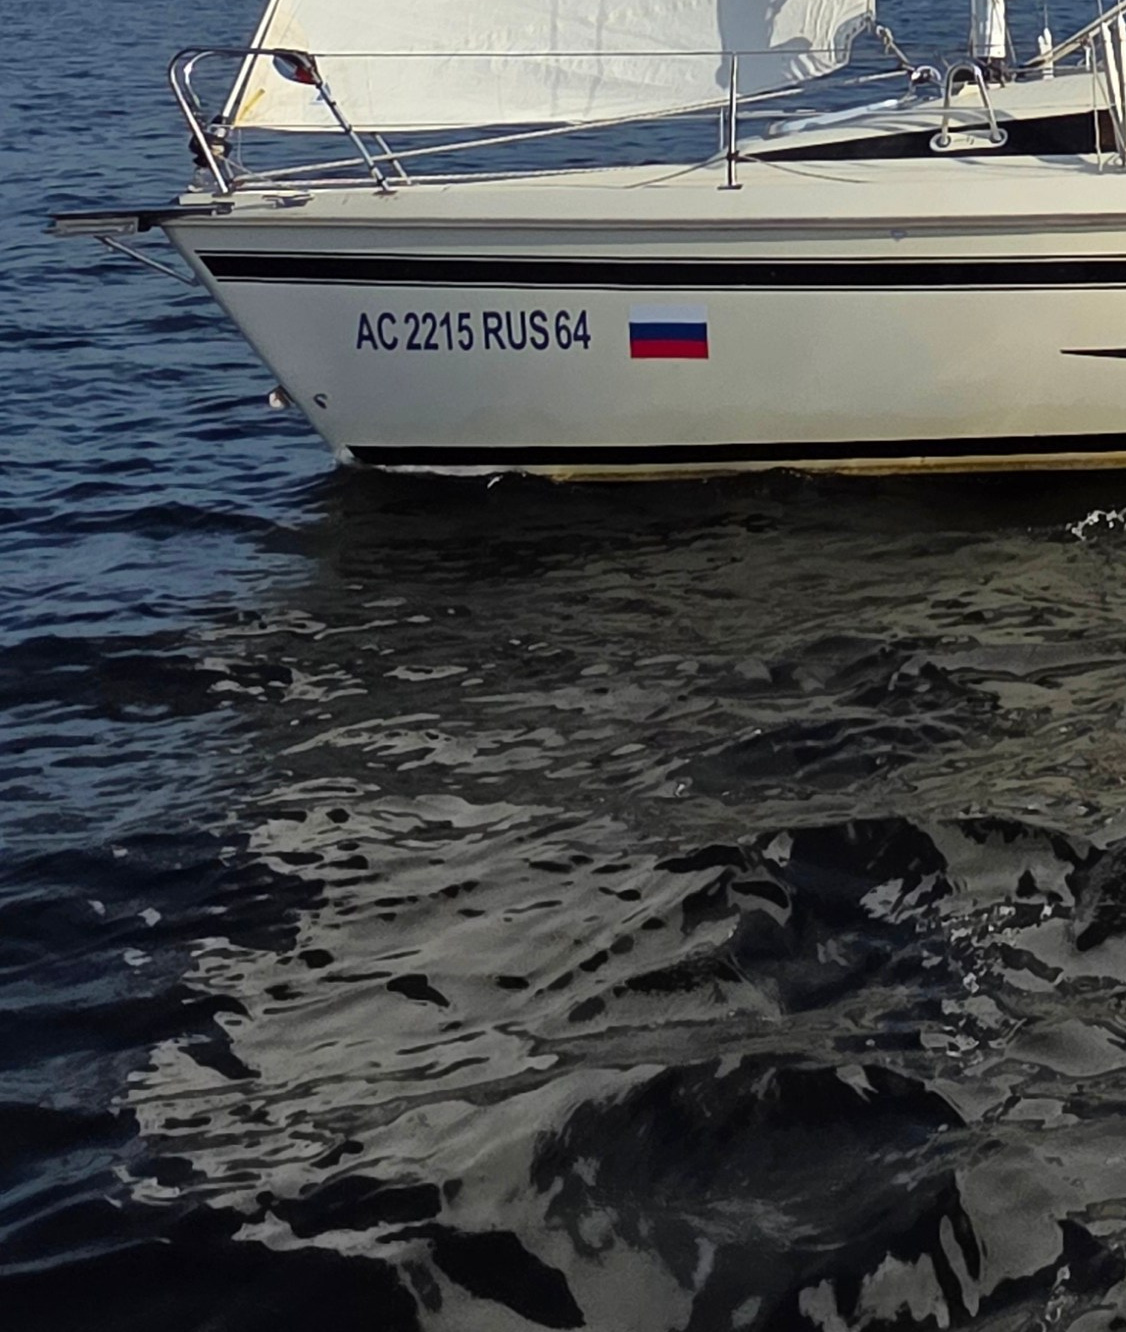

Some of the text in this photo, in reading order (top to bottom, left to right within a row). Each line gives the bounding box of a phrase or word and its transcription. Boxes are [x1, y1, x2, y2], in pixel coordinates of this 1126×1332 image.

[356, 310, 591, 350] AC 2215 RUS 64
